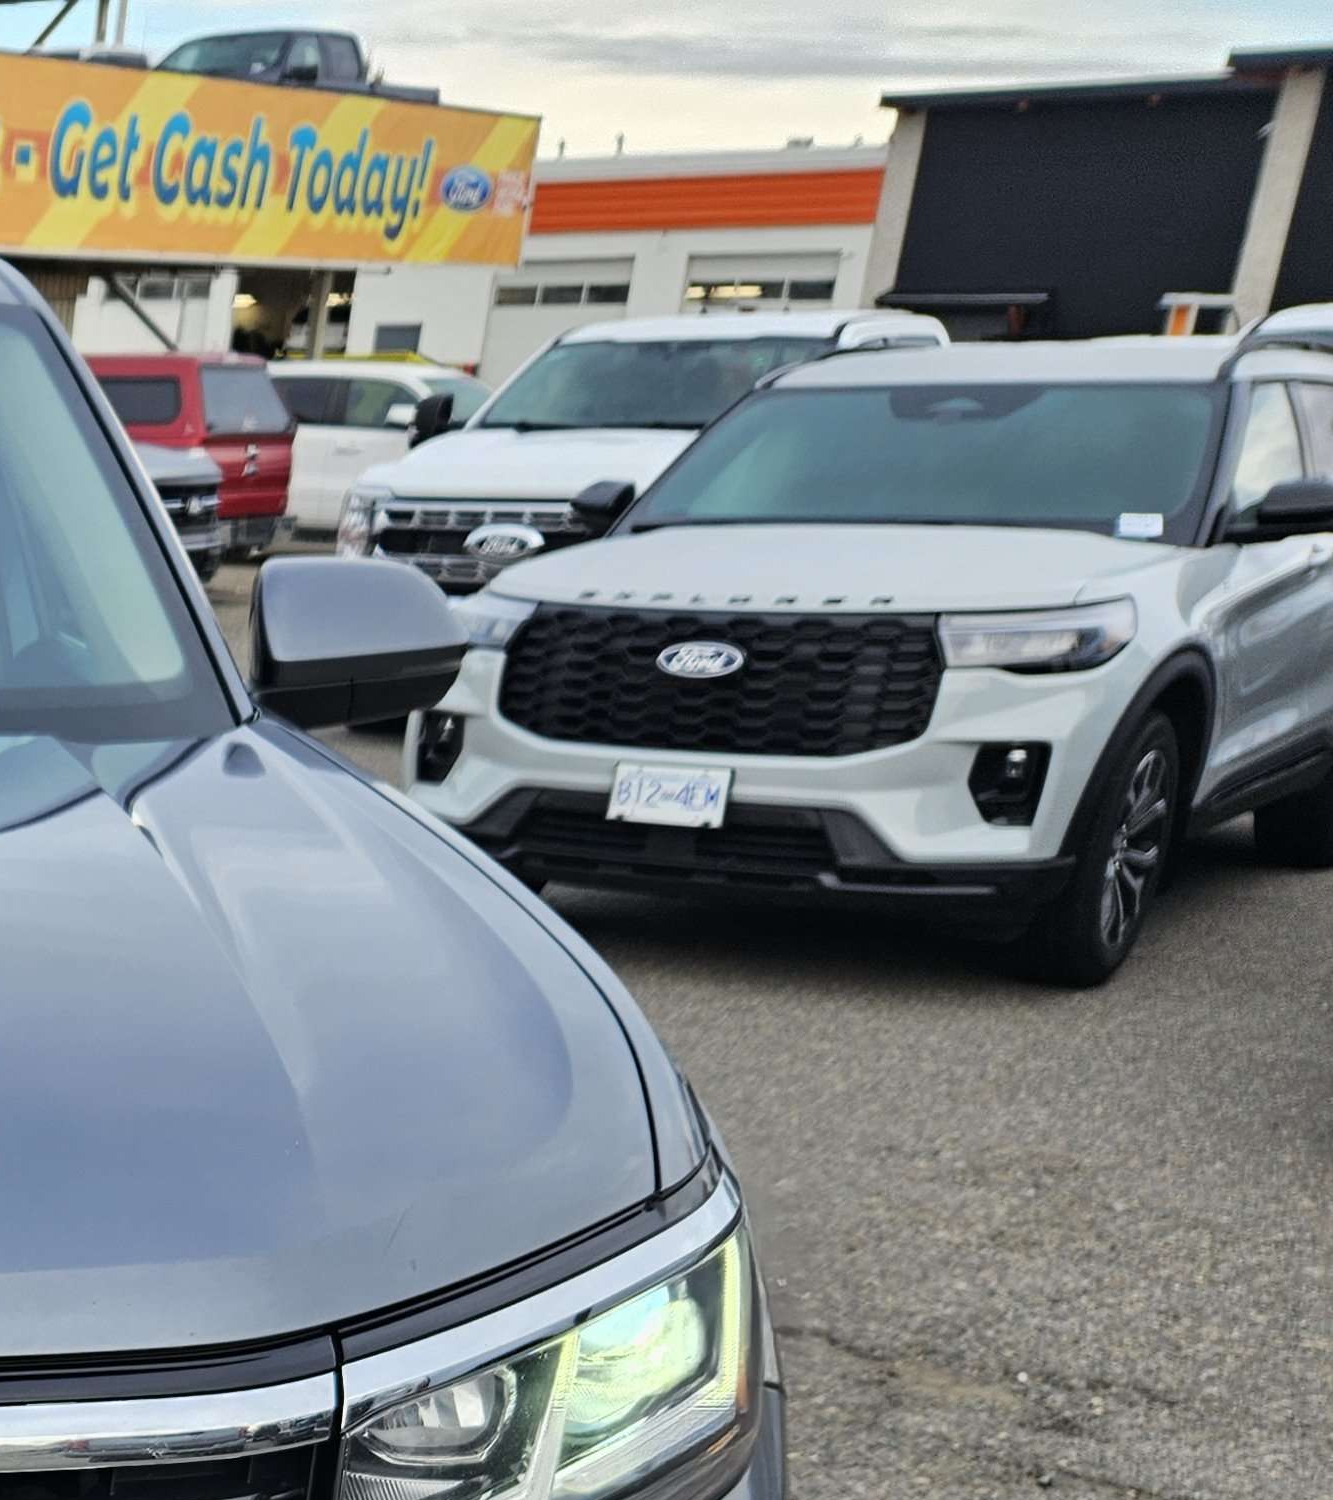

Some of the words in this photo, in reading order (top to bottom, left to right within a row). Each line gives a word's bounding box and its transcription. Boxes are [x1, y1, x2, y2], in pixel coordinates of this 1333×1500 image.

[50, 100, 141, 202] Get
[152, 111, 273, 210] Cash
[286, 126, 433, 241] Today!
